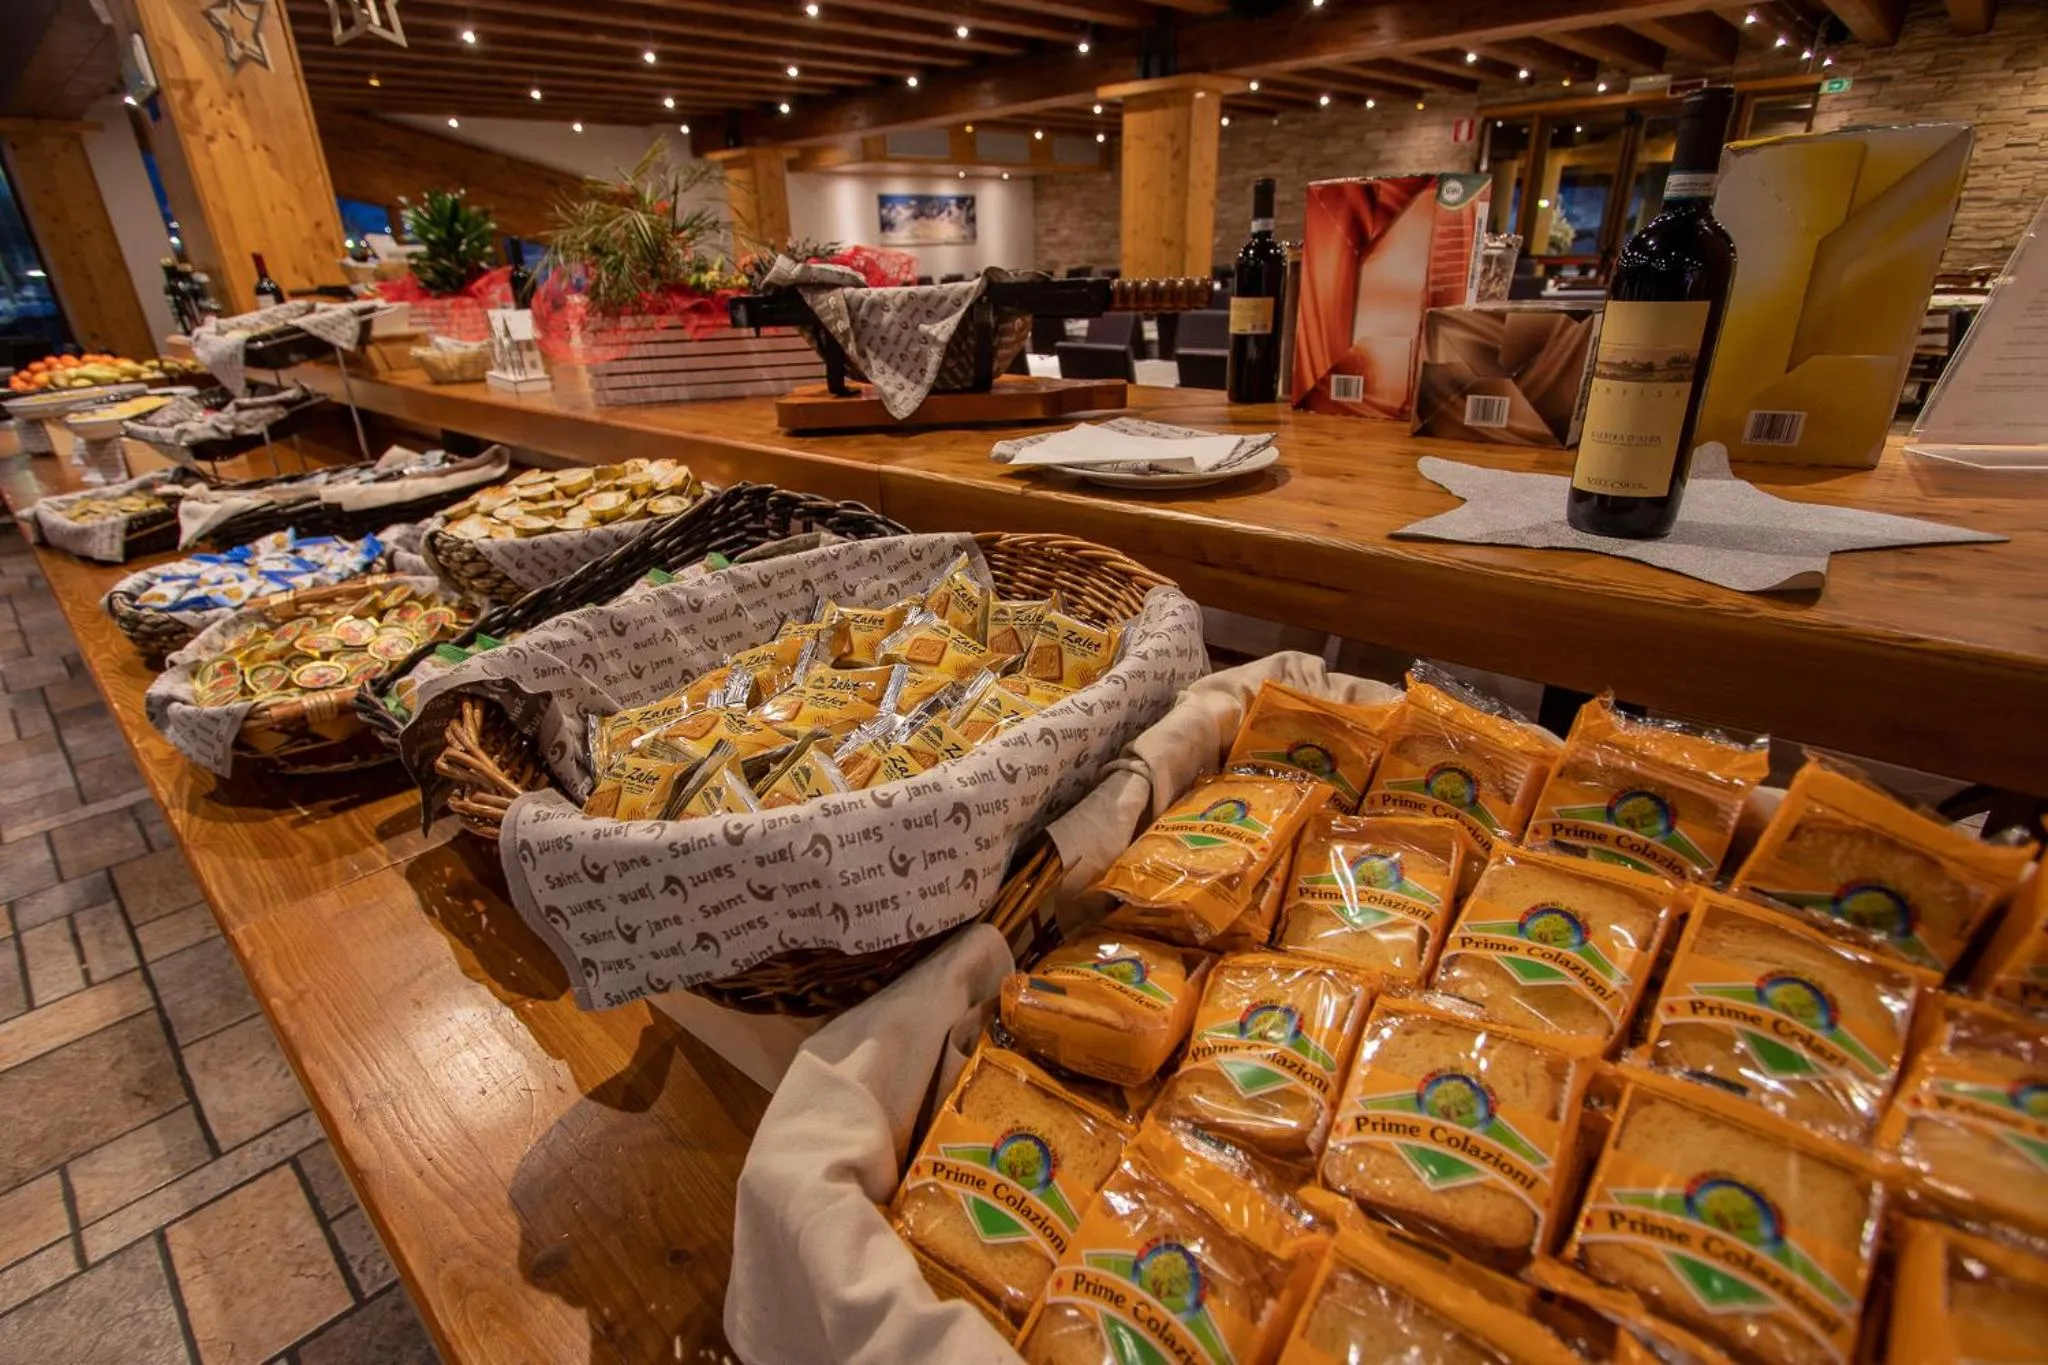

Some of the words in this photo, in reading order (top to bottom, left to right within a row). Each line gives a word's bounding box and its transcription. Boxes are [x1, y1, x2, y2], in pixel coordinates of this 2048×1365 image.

[953, 584, 979, 610] Zalet
[850, 613, 885, 626] Zalet
[1062, 630, 1101, 650] Zalet
[533, 666, 566, 679] Saint
[638, 704, 684, 722] Zalet
[974, 799, 1009, 817] Saint
[1381, 794, 1427, 812] Prime
[544, 870, 584, 891] Saint
[613, 854, 651, 878] Jane
[668, 833, 718, 860] Saint
[761, 813, 802, 836] Jane
[820, 798, 868, 818] Saint
[905, 780, 943, 801] Jane
[957, 768, 997, 789] Saint
[902, 808, 938, 831] Jane
[1154, 822, 1198, 833] Prime
[537, 834, 574, 855] Saint
[837, 825, 884, 848] Saint
[754, 842, 796, 868] Jane
[1550, 823, 1608, 843] Prime
[1615, 833, 1688, 880] Colazio
[688, 863, 736, 887] Saint
[580, 927, 617, 946] Saint
[647, 914, 684, 938] Jane
[698, 893, 748, 919] Saint
[782, 877, 823, 897] Jane
[838, 862, 886, 888] Saint
[922, 847, 958, 870] Jane
[617, 884, 655, 902] Jane
[917, 876, 951, 900] Jane
[568, 899, 606, 916] Saint
[787, 902, 821, 920] Jane
[854, 894, 901, 919] Saint
[722, 914, 770, 941] Saint
[650, 941, 685, 961] Jane
[1460, 936, 1520, 954] Prime
[1527, 945, 1617, 1003] Colazioni
[603, 985, 647, 1008] Saint
[1690, 1000, 1763, 1028] Prime
[1355, 1115, 1421, 1138] Prime
[1429, 1126, 1538, 1192] Colazioni
[931, 1161, 988, 1192] Prime
[1608, 1210, 1692, 1246] Prime
[1072, 1272, 1128, 1310] Prime
[1132, 1300, 1199, 1365] Colazi
